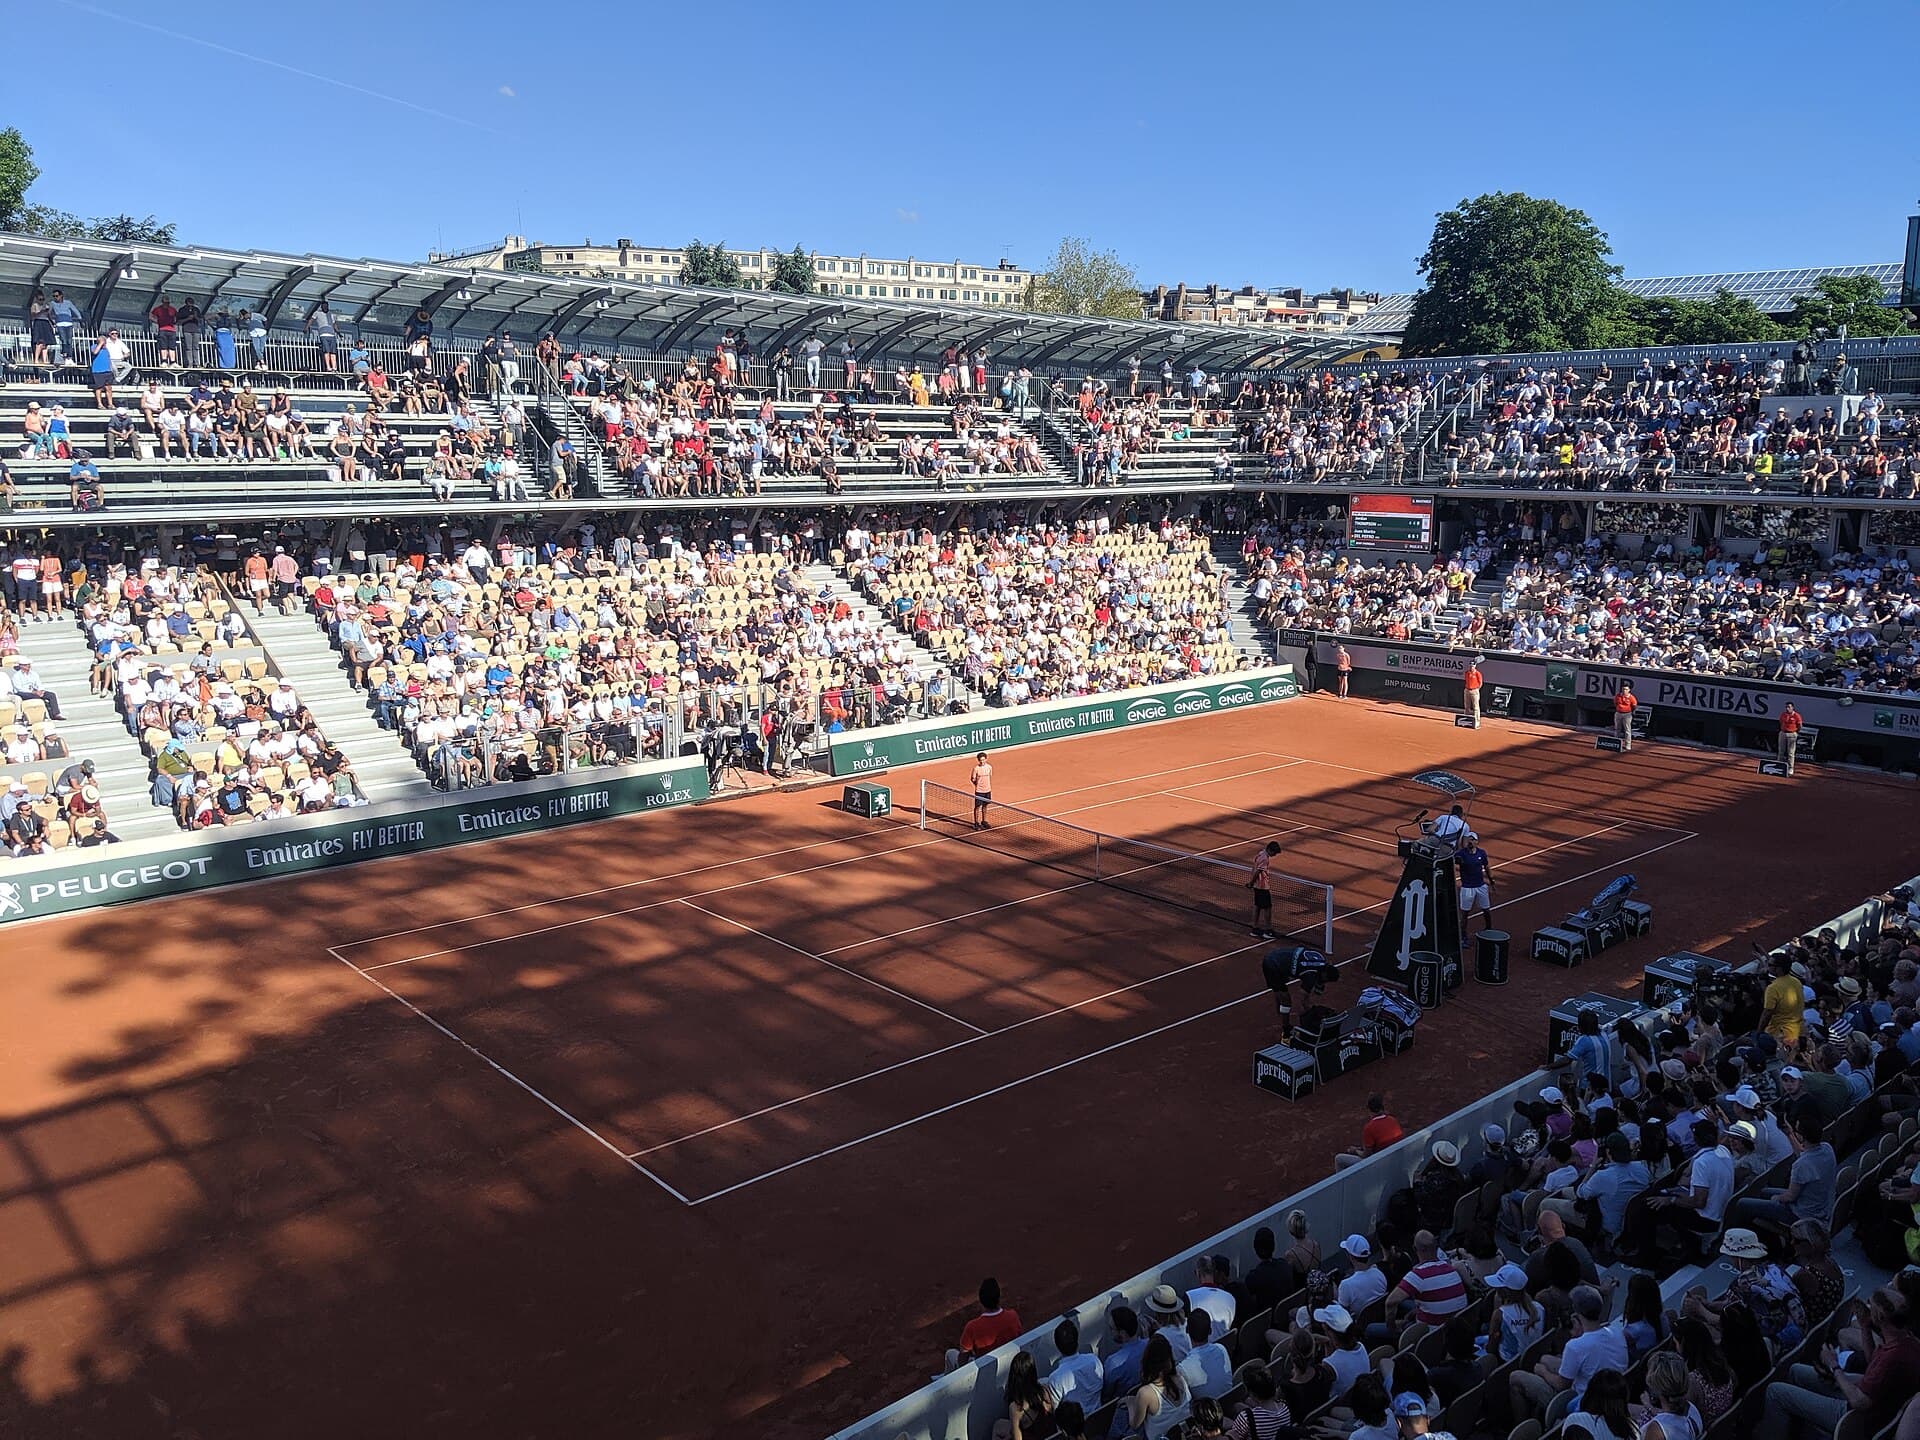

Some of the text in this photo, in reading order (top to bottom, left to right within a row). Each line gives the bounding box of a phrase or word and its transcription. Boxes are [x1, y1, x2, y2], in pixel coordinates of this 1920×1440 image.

[1402, 654, 1464, 670] BNP PARIBAS
[1384, 679, 1431, 691] BNP PARIBAS
[1585, 673, 1769, 715] BNP PARIBAS
[1029, 708, 1115, 735] Emirates FLY BETTER
[915, 725, 1012, 754] Emirates FLY BETTER
[853, 756, 890, 770] ROLEX
[646, 788, 692, 806] ROLEX
[458, 791, 610, 833] Emirates FLY BETTER
[30, 821, 425, 903] PEUGEOT Emirates FLY BETTER
[1535, 937, 1569, 958] perrier
[1257, 1060, 1291, 1087] perrier
